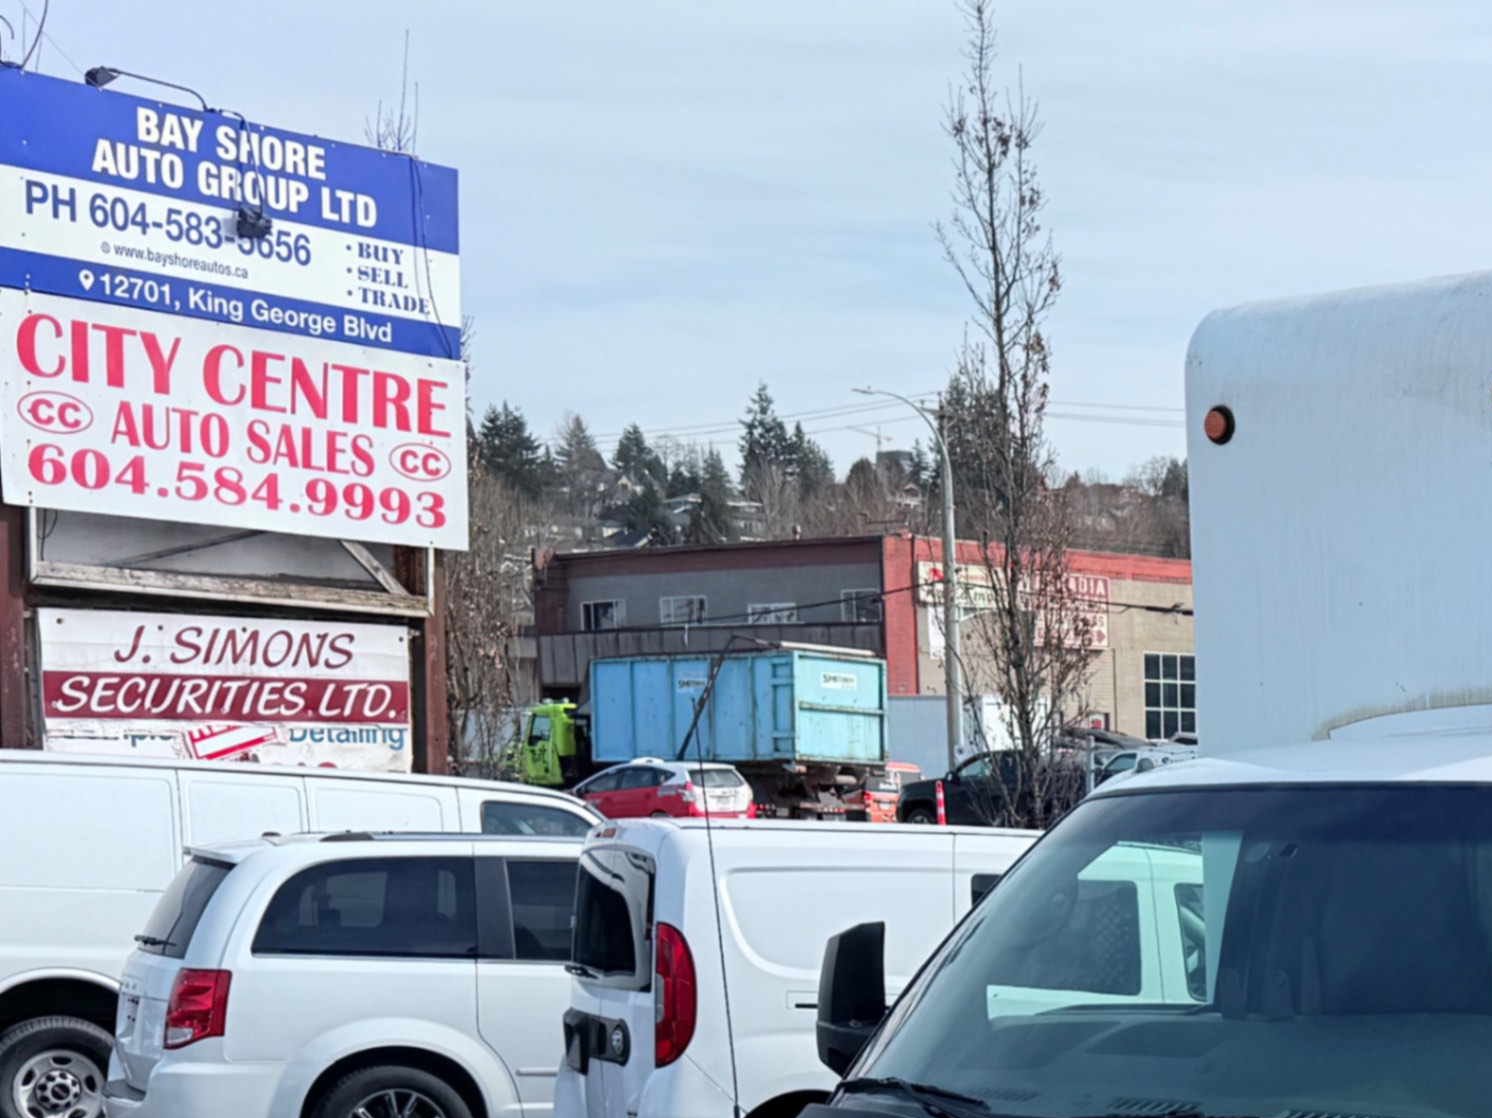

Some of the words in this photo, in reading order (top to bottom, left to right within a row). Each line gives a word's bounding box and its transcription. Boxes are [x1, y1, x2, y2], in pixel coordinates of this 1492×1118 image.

[136, 106, 203, 152] BAY
[216, 125, 326, 180] SHORE
[25, 179, 77, 222] PH
[92, 139, 184, 189] AUTO
[197, 161, 309, 213] GROUP
[321, 186, 377, 228] LTD
[113, 242, 249, 279] www.bayshoreautos.ca
[358, 242, 404, 265] BUY
[358, 265, 408, 289] SELL
[100, 273, 181, 310] 12701,
[188, 289, 244, 323] King
[251, 303, 336, 334] George
[344, 309, 392, 343] Blvd
[358, 286, 430, 315] TRADE
[16, 314, 181, 395] CITY
[202, 344, 451, 438] CENTRE
[111, 401, 229, 458] AUTO
[247, 420, 375, 477] SALES
[28, 444, 447, 529] 604.584.9993
[114, 625, 151, 663] J.
[170, 626, 355, 669] SIMONS
[55, 676, 306, 716] SECURITIES
[318, 682, 397, 719] LTD.
